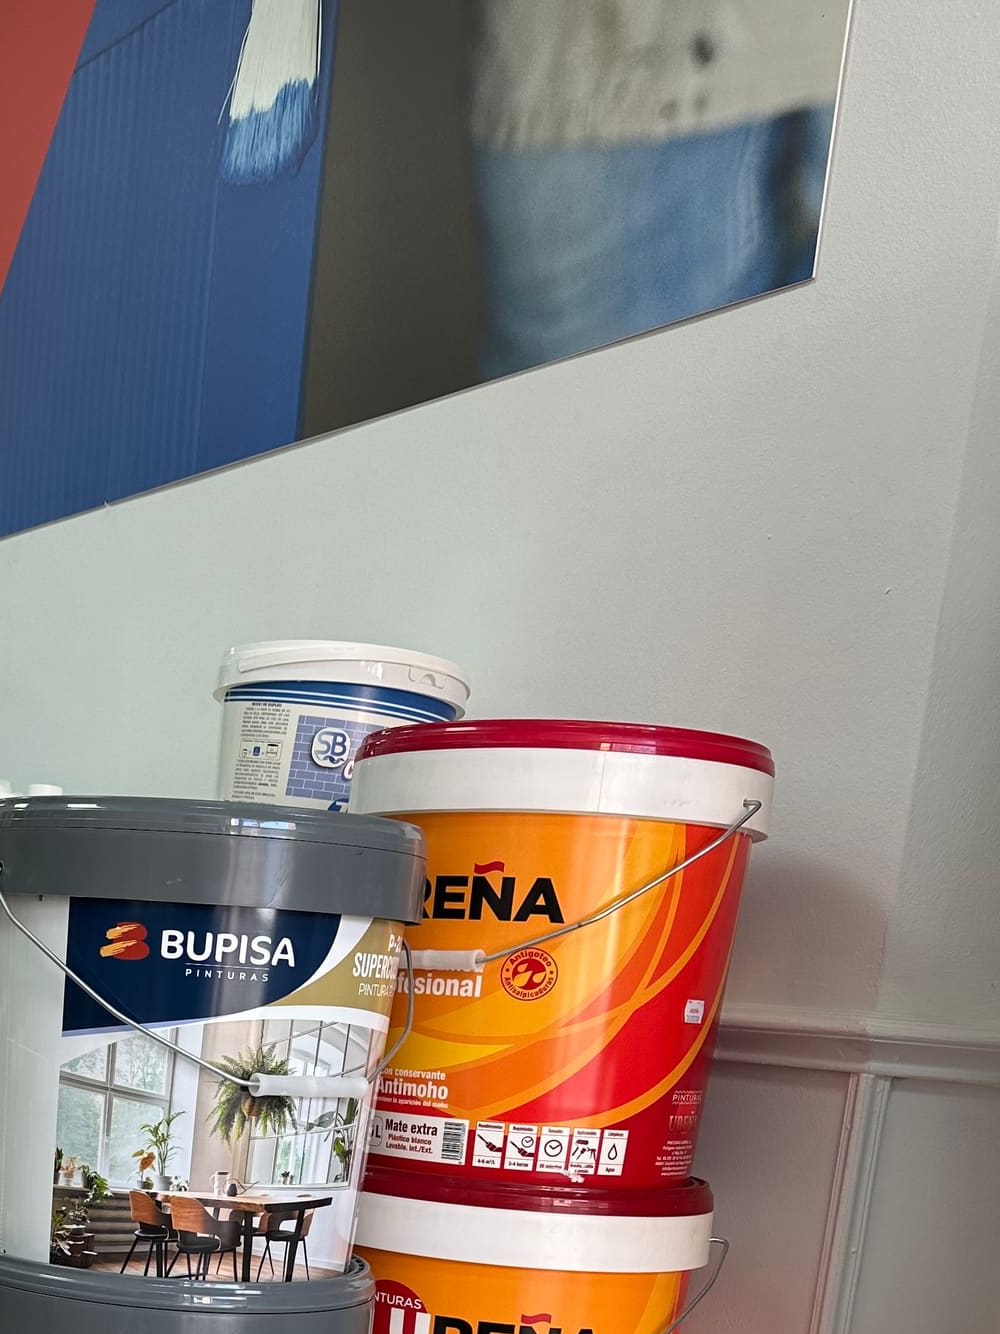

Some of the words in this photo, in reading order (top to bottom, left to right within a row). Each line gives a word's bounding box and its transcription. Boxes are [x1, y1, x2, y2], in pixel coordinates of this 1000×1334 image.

[315, 731, 347, 757] SB
[160, 929, 295, 968] BUPISA
[508, 949, 553, 968] Antigoteo
[185, 968, 270, 982] PINTURAS
[394, 1068, 446, 1081] conservante
[378, 1076, 448, 1100] Antimoho
[385, 1119, 408, 1133] Mate
[411, 1122, 438, 1136] extra
[370, 1292, 423, 1311] NTURAS
